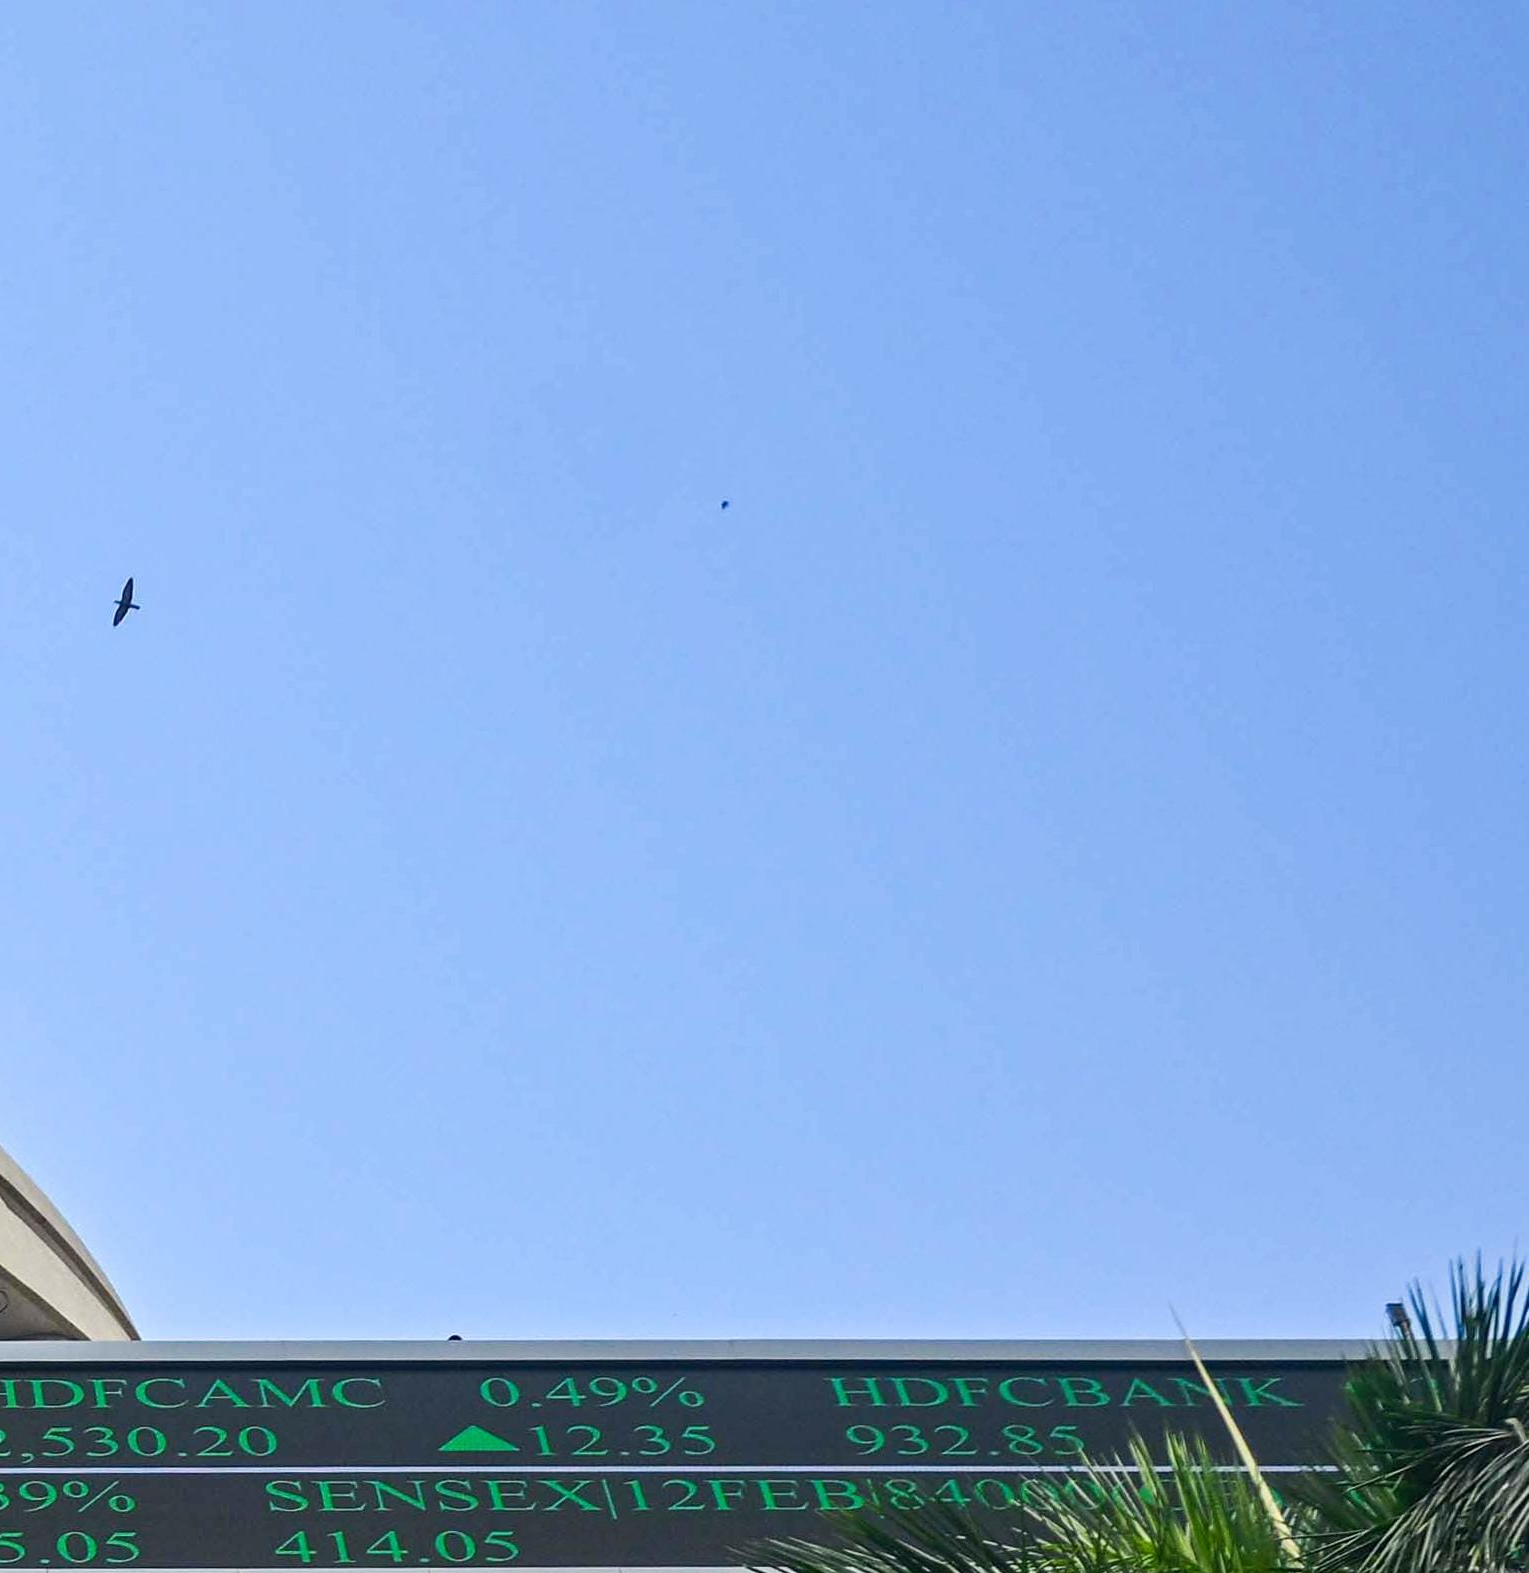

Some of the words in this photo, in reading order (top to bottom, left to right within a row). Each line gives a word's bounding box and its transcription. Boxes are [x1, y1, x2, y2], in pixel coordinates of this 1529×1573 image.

[479, 1376, 706, 1408] 0.49%
[823, 1375, 1306, 1408] HDFCBANK
[534, 1424, 718, 1456] 12.35
[845, 1424, 1086, 1456] 932.85
[273, 1531, 521, 1564] 414.05
